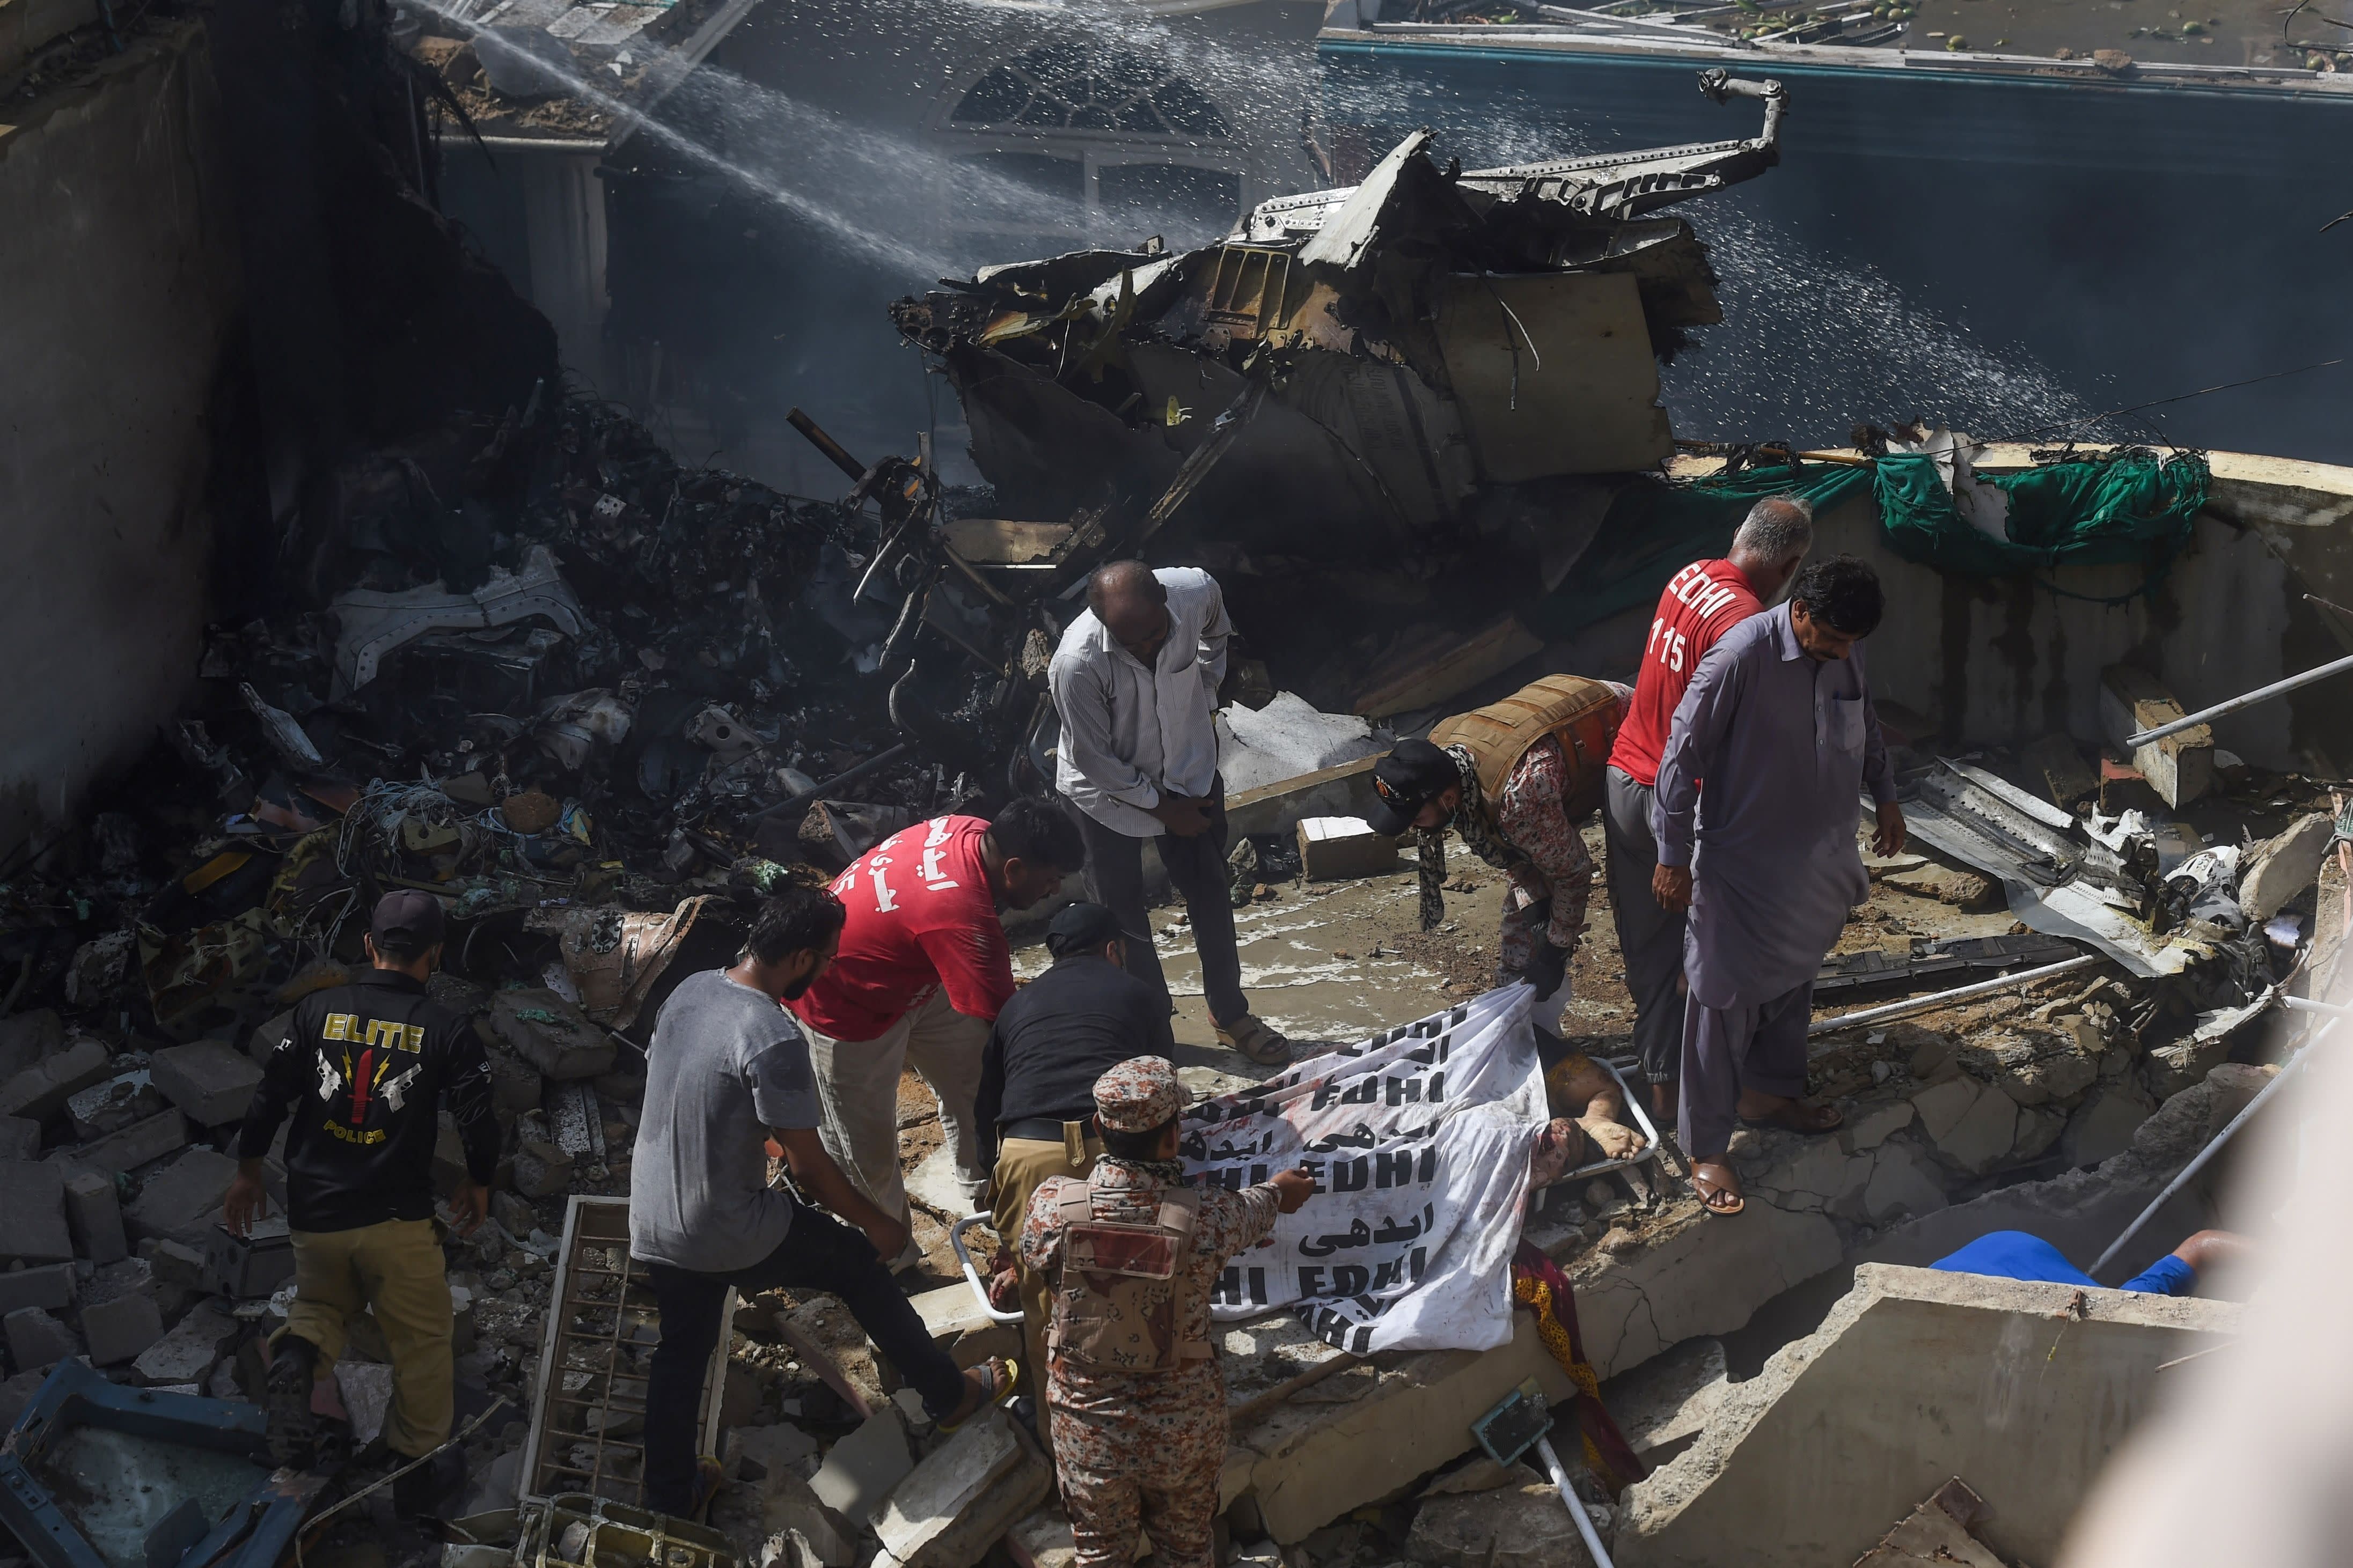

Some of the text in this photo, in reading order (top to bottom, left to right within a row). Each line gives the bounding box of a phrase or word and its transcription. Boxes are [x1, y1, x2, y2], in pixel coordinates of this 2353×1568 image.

[1668, 563, 1736, 619] EDHI
[1649, 617, 1686, 673] 115
[322, 1013, 425, 1054] ELITE
[323, 1120, 386, 1144] POLICE
[1300, 1145, 1435, 1194] EDHI
[1298, 1247, 1426, 1298] EDHI
